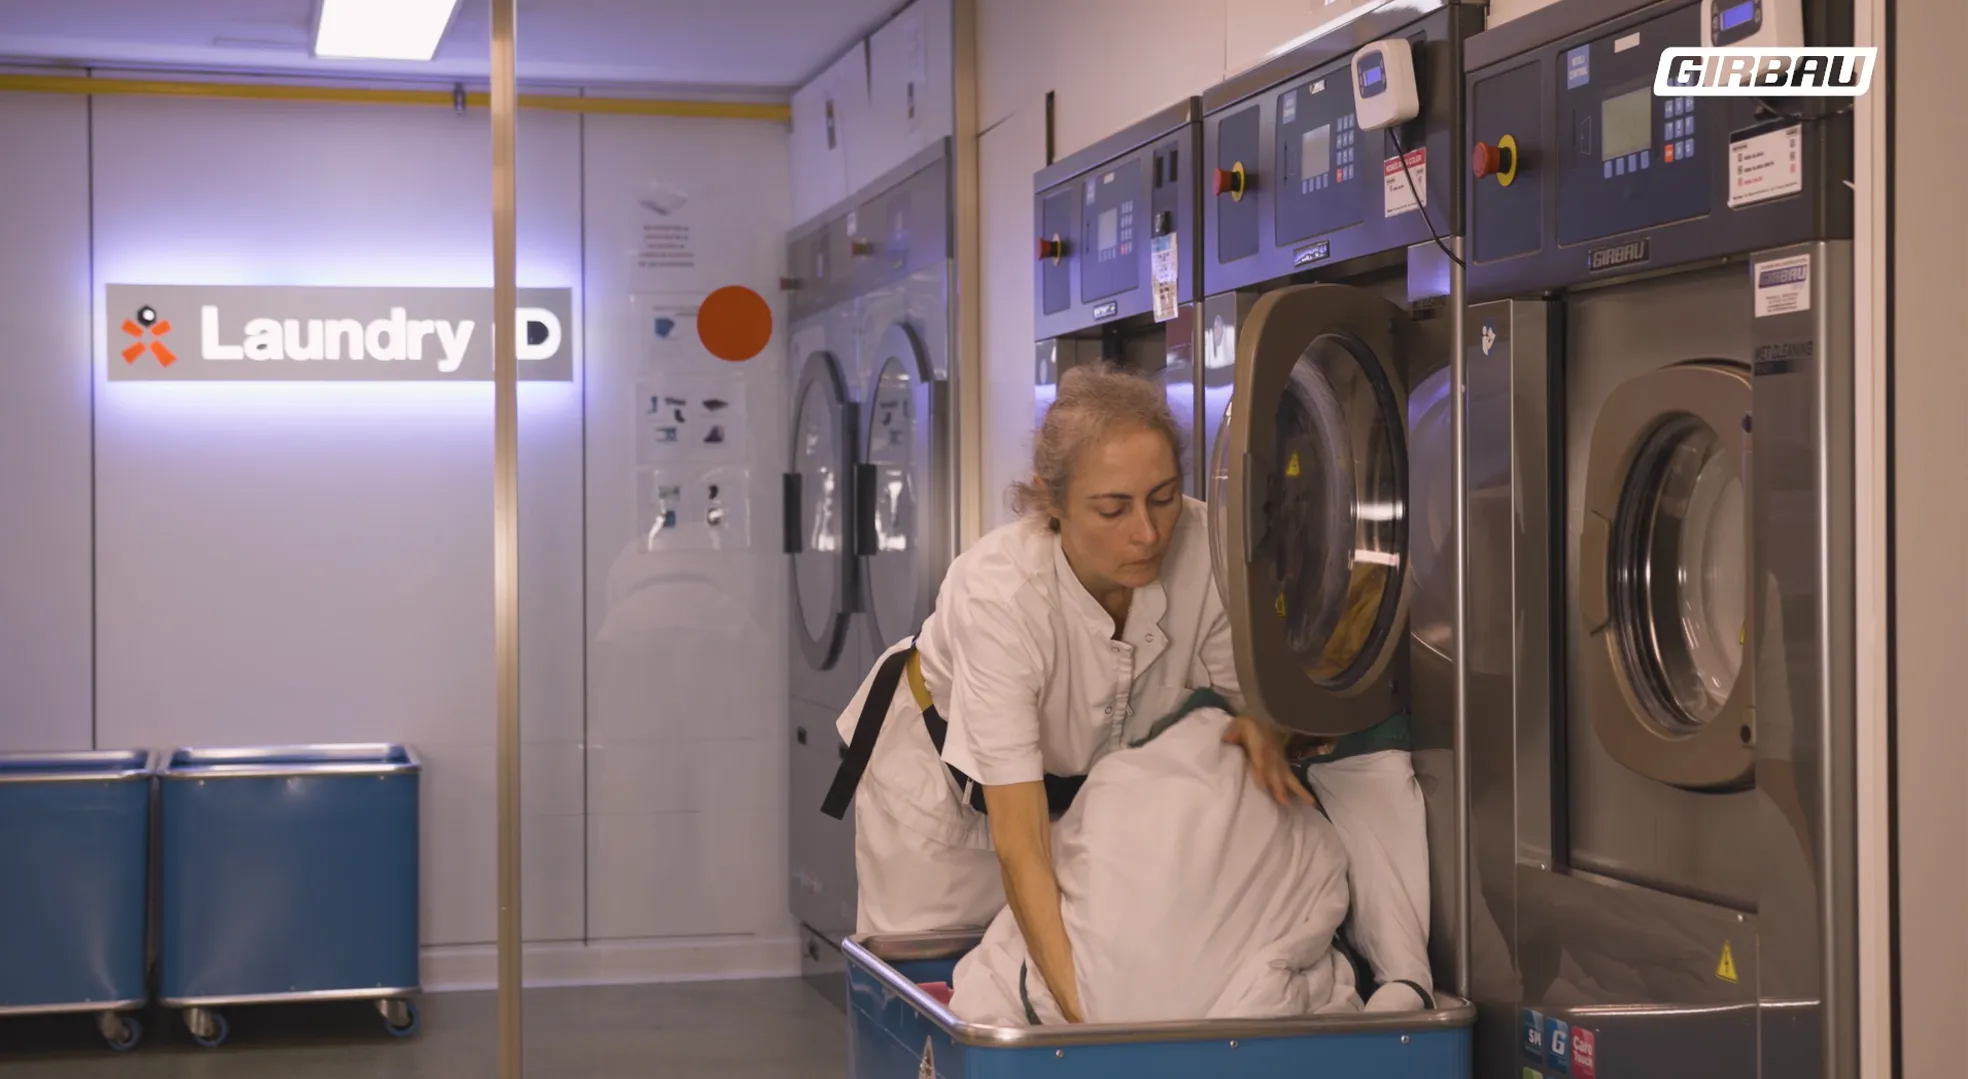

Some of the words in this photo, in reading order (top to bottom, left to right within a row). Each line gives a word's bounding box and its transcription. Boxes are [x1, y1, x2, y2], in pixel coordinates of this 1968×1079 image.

[1592, 241, 1645, 268] GIRBAU
[201, 305, 474, 372] Laundry
[512, 306, 562, 361] D
[1552, 1030, 1567, 1055] G
[1573, 1036, 1593, 1055] Care
